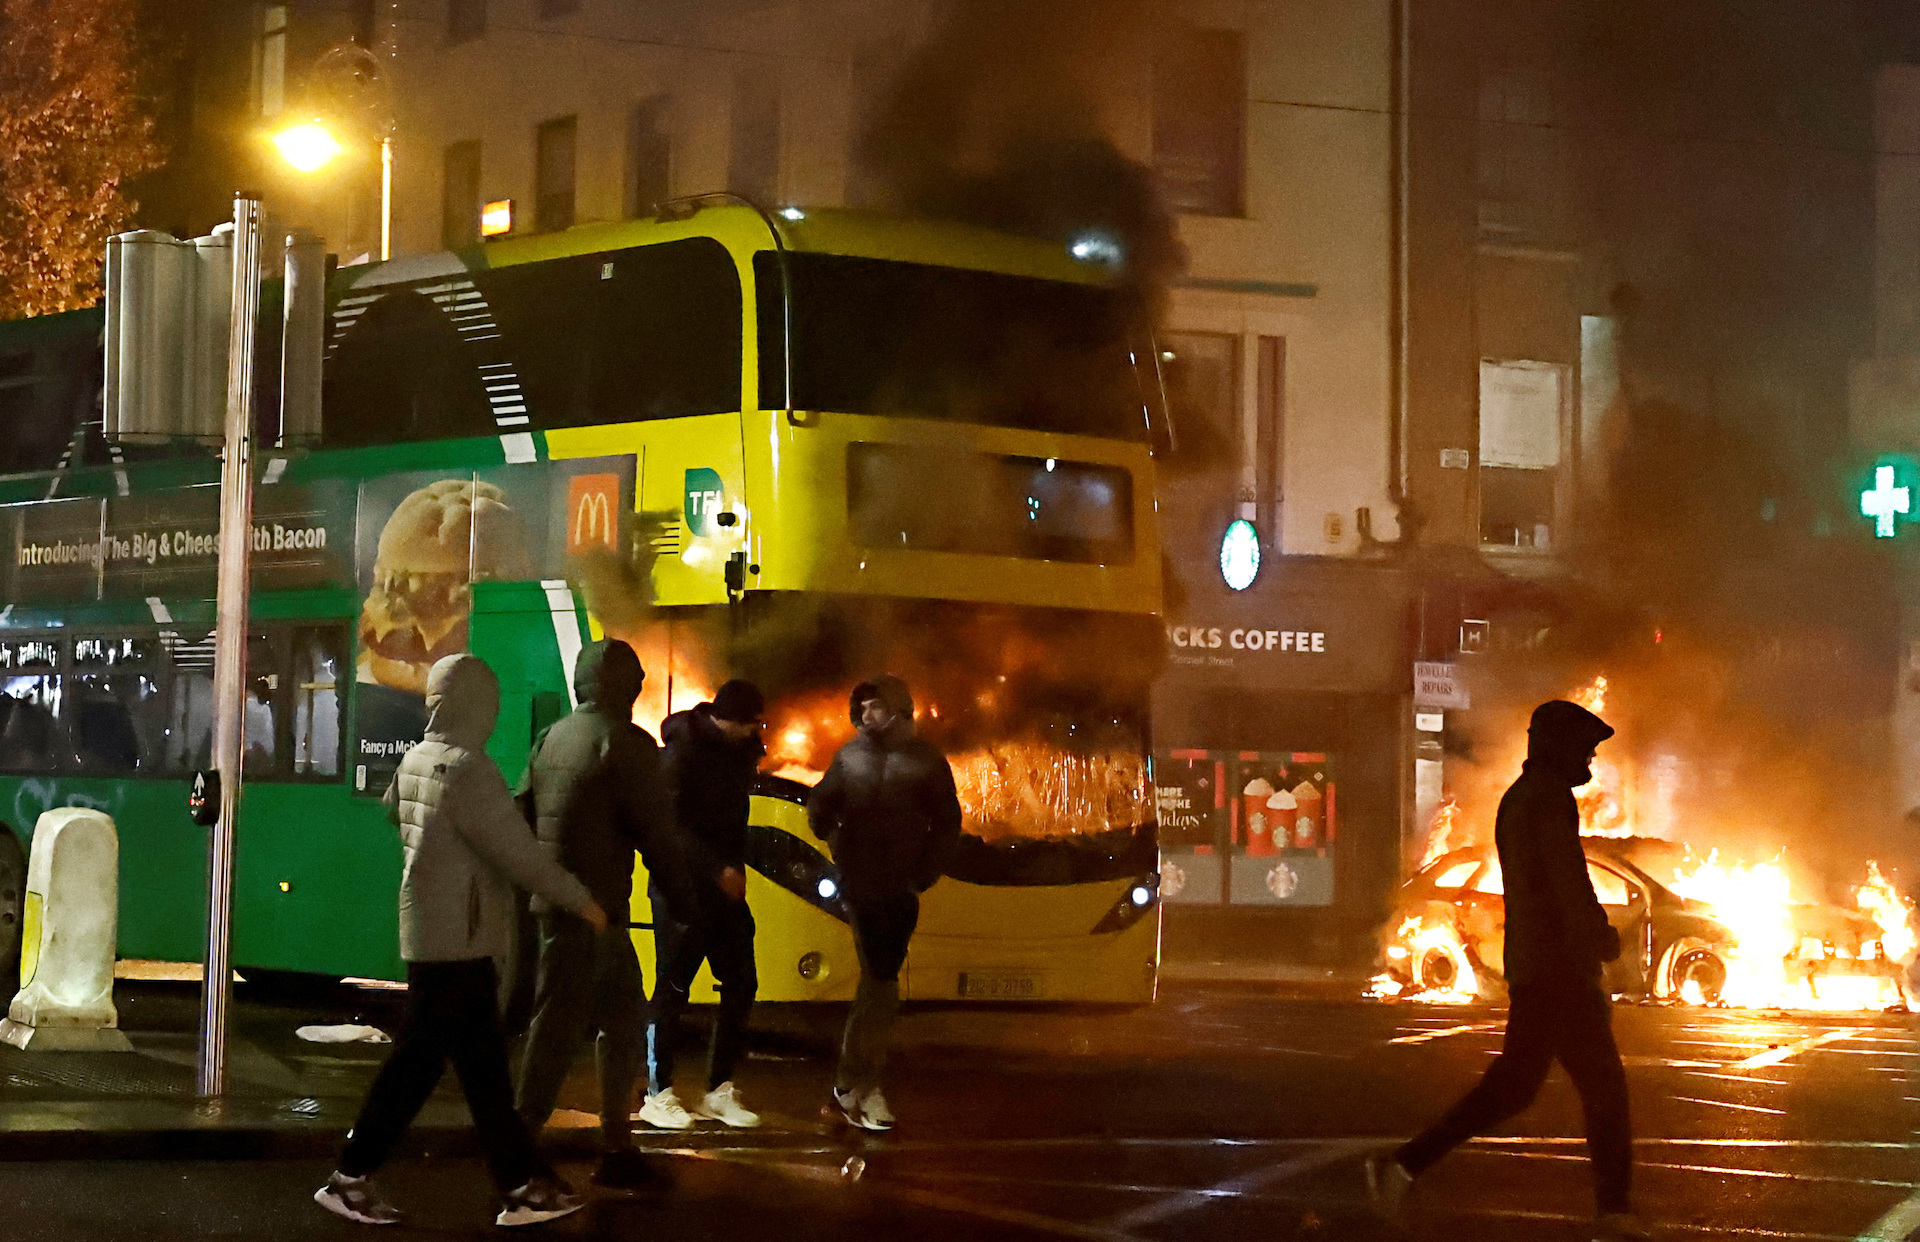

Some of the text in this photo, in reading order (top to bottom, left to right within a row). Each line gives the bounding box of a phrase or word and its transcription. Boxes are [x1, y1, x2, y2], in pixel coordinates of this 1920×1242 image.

[18, 523, 327, 570] Introducing The Big & Chees ith Bacon
[1166, 626, 1325, 653] CKS COFFEE
[360, 738, 417, 758] Fancy a McD
[1156, 810, 1200, 830] lidays
